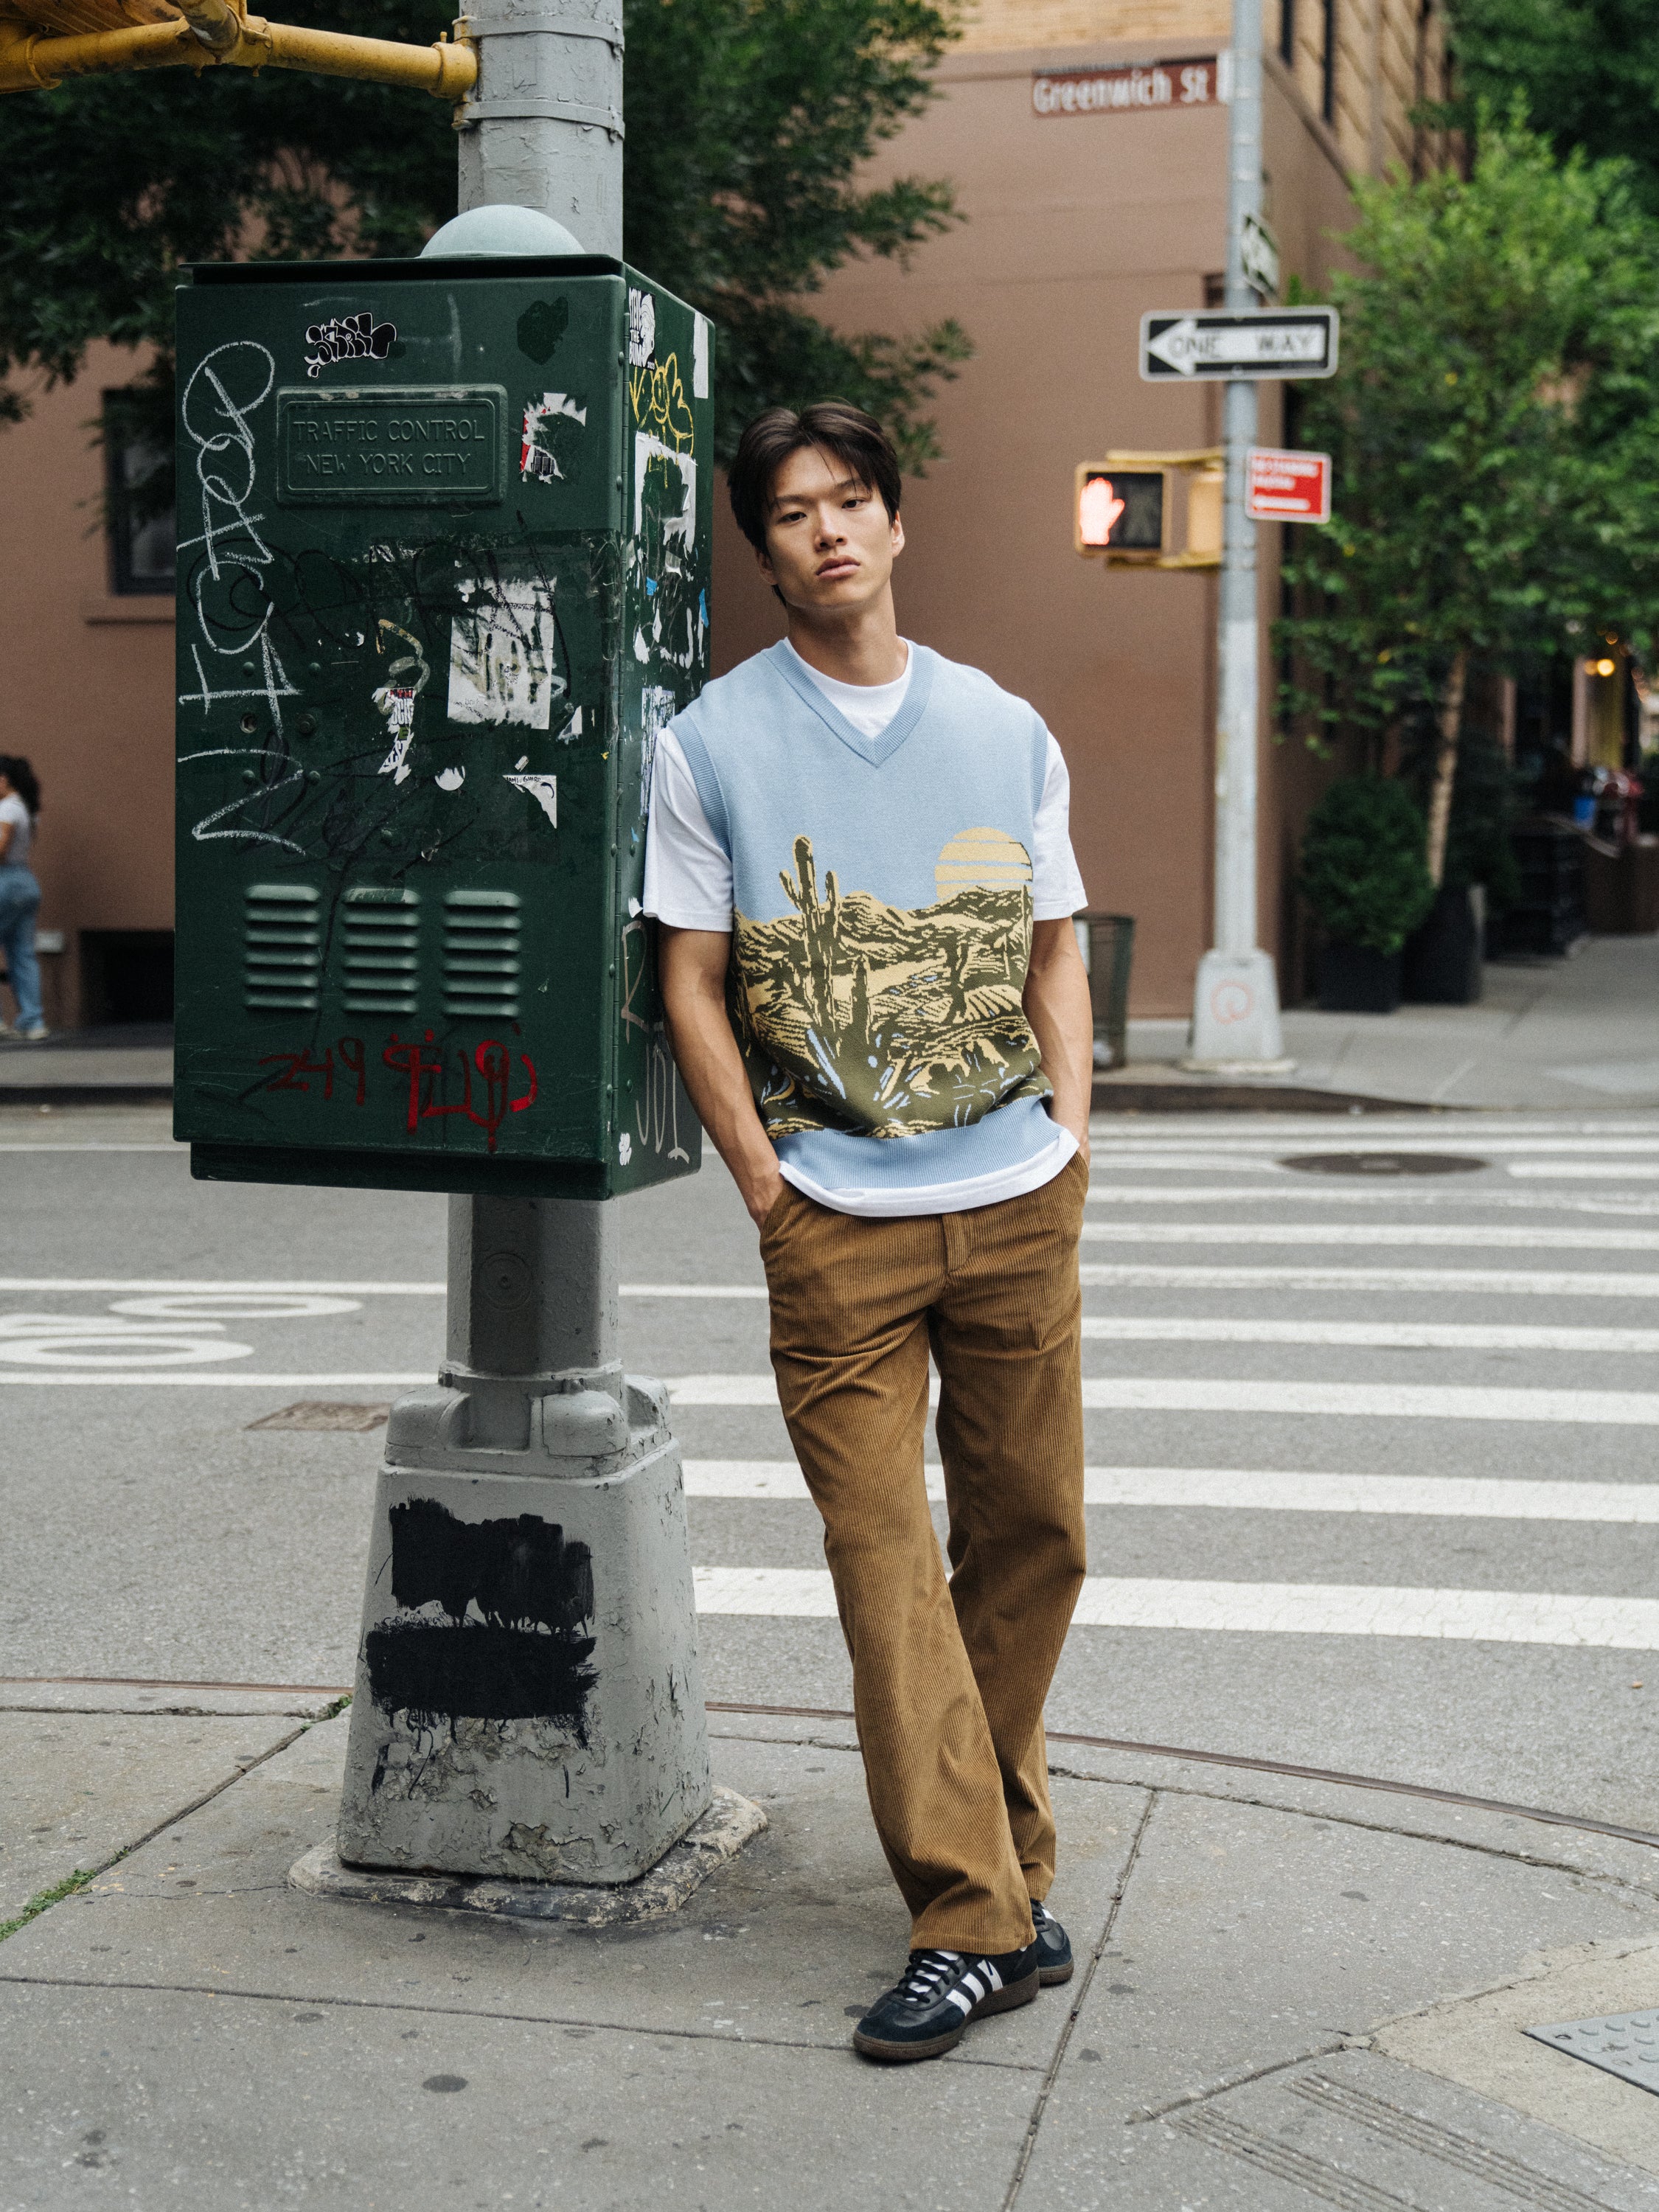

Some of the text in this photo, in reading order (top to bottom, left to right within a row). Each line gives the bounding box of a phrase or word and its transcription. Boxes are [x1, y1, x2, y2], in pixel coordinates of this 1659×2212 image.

[1033, 65, 1208, 114] Greenwich St
[630, 330, 640, 343] THE
[1168, 332, 1313, 359] ONE WAY
[293, 420, 485, 442] TRAFFIC CONTROL
[307, 453, 471, 474] NEW YORK CITY
